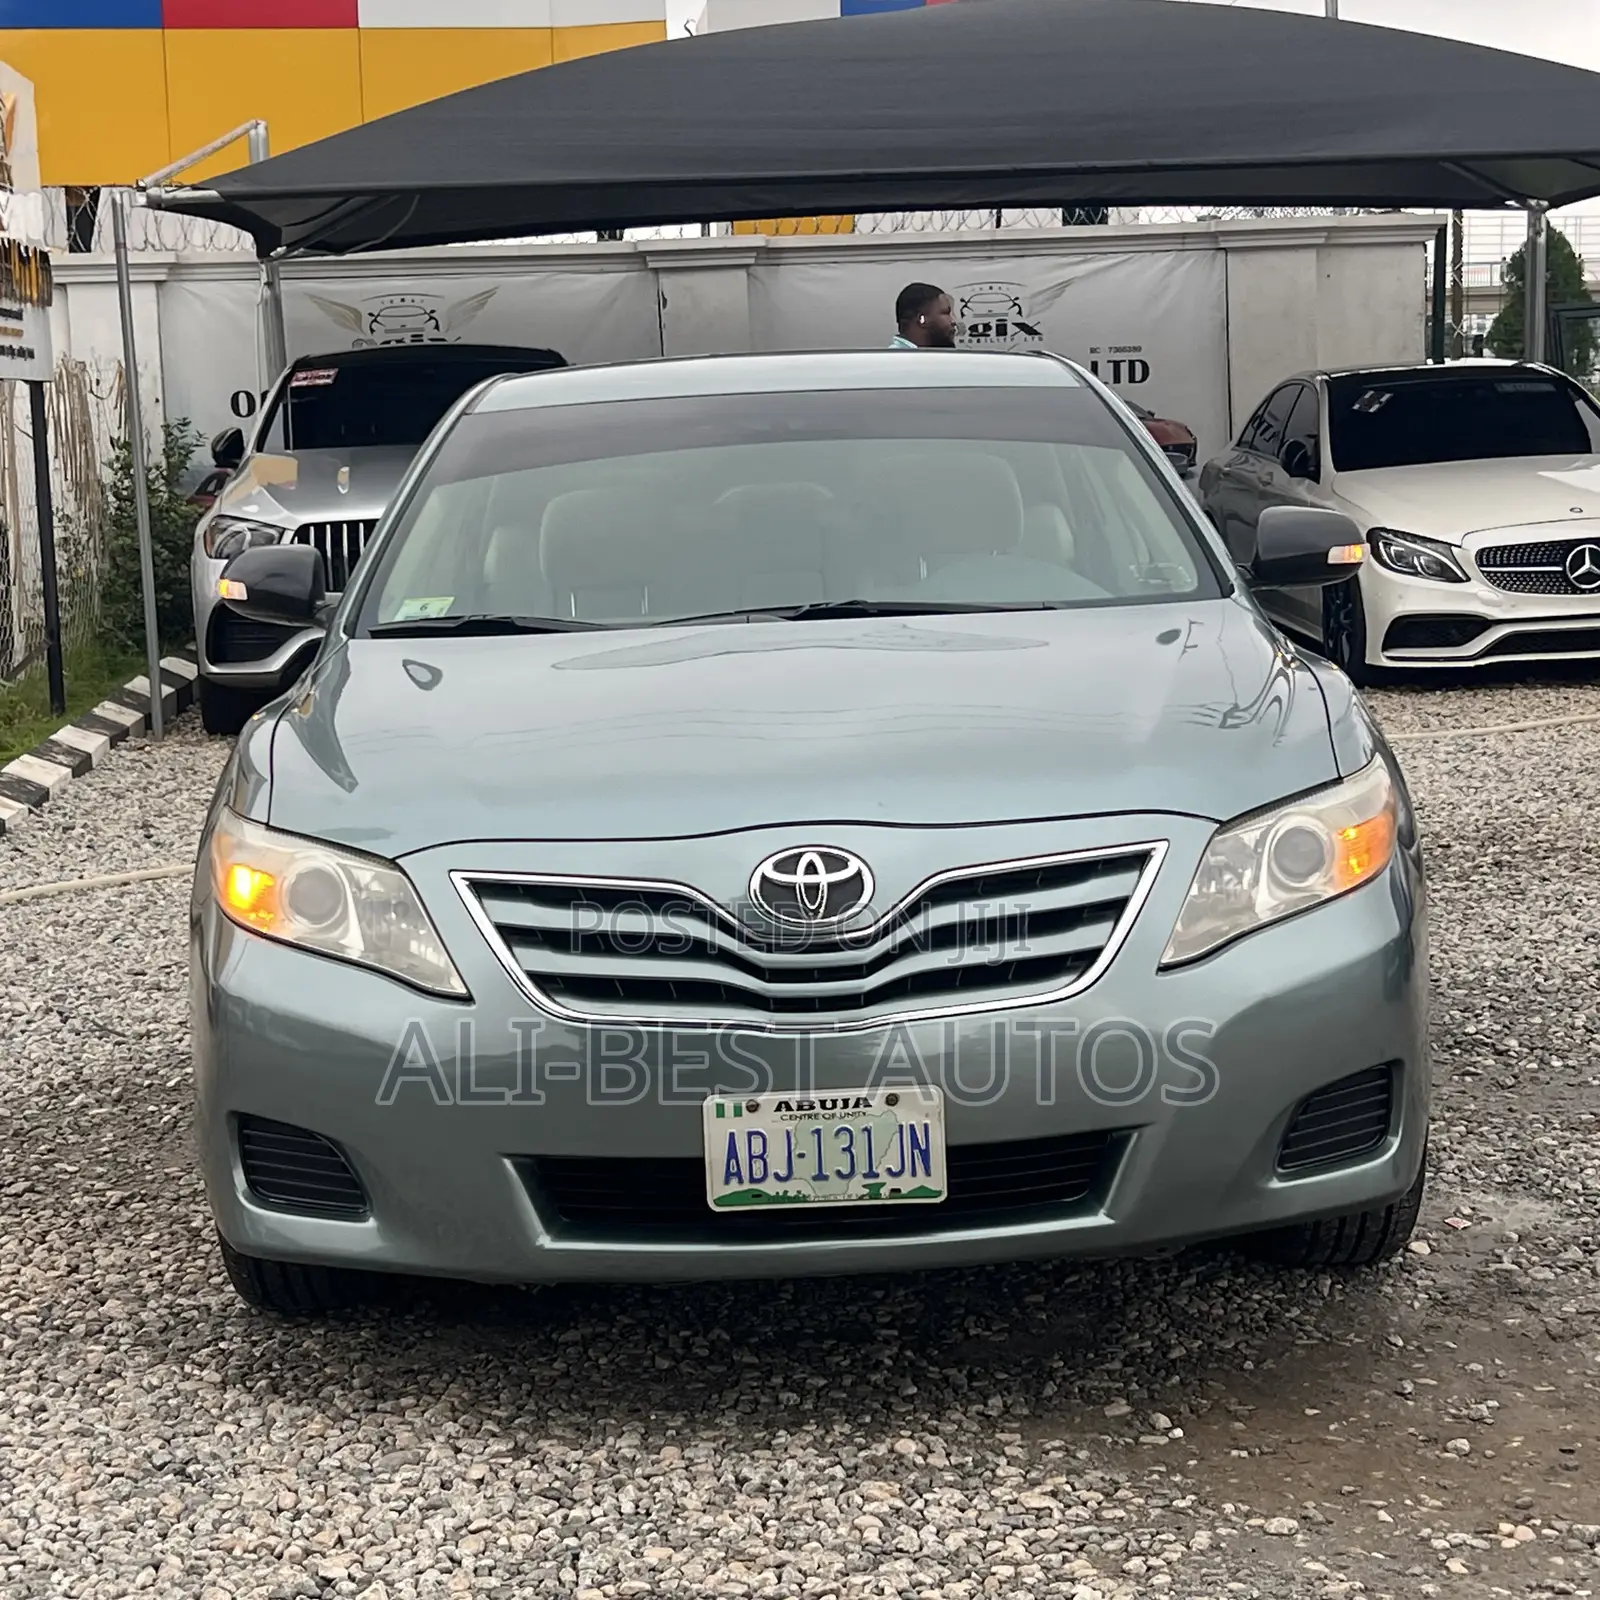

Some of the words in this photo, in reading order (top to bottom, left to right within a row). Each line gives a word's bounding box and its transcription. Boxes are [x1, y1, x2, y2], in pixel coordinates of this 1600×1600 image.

[773, 1096, 873, 1112] ABUJA
[780, 1113, 820, 1121] CENTRE
[838, 1110, 867, 1120] UNITY
[723, 1122, 932, 1186] ABJ-131JN
